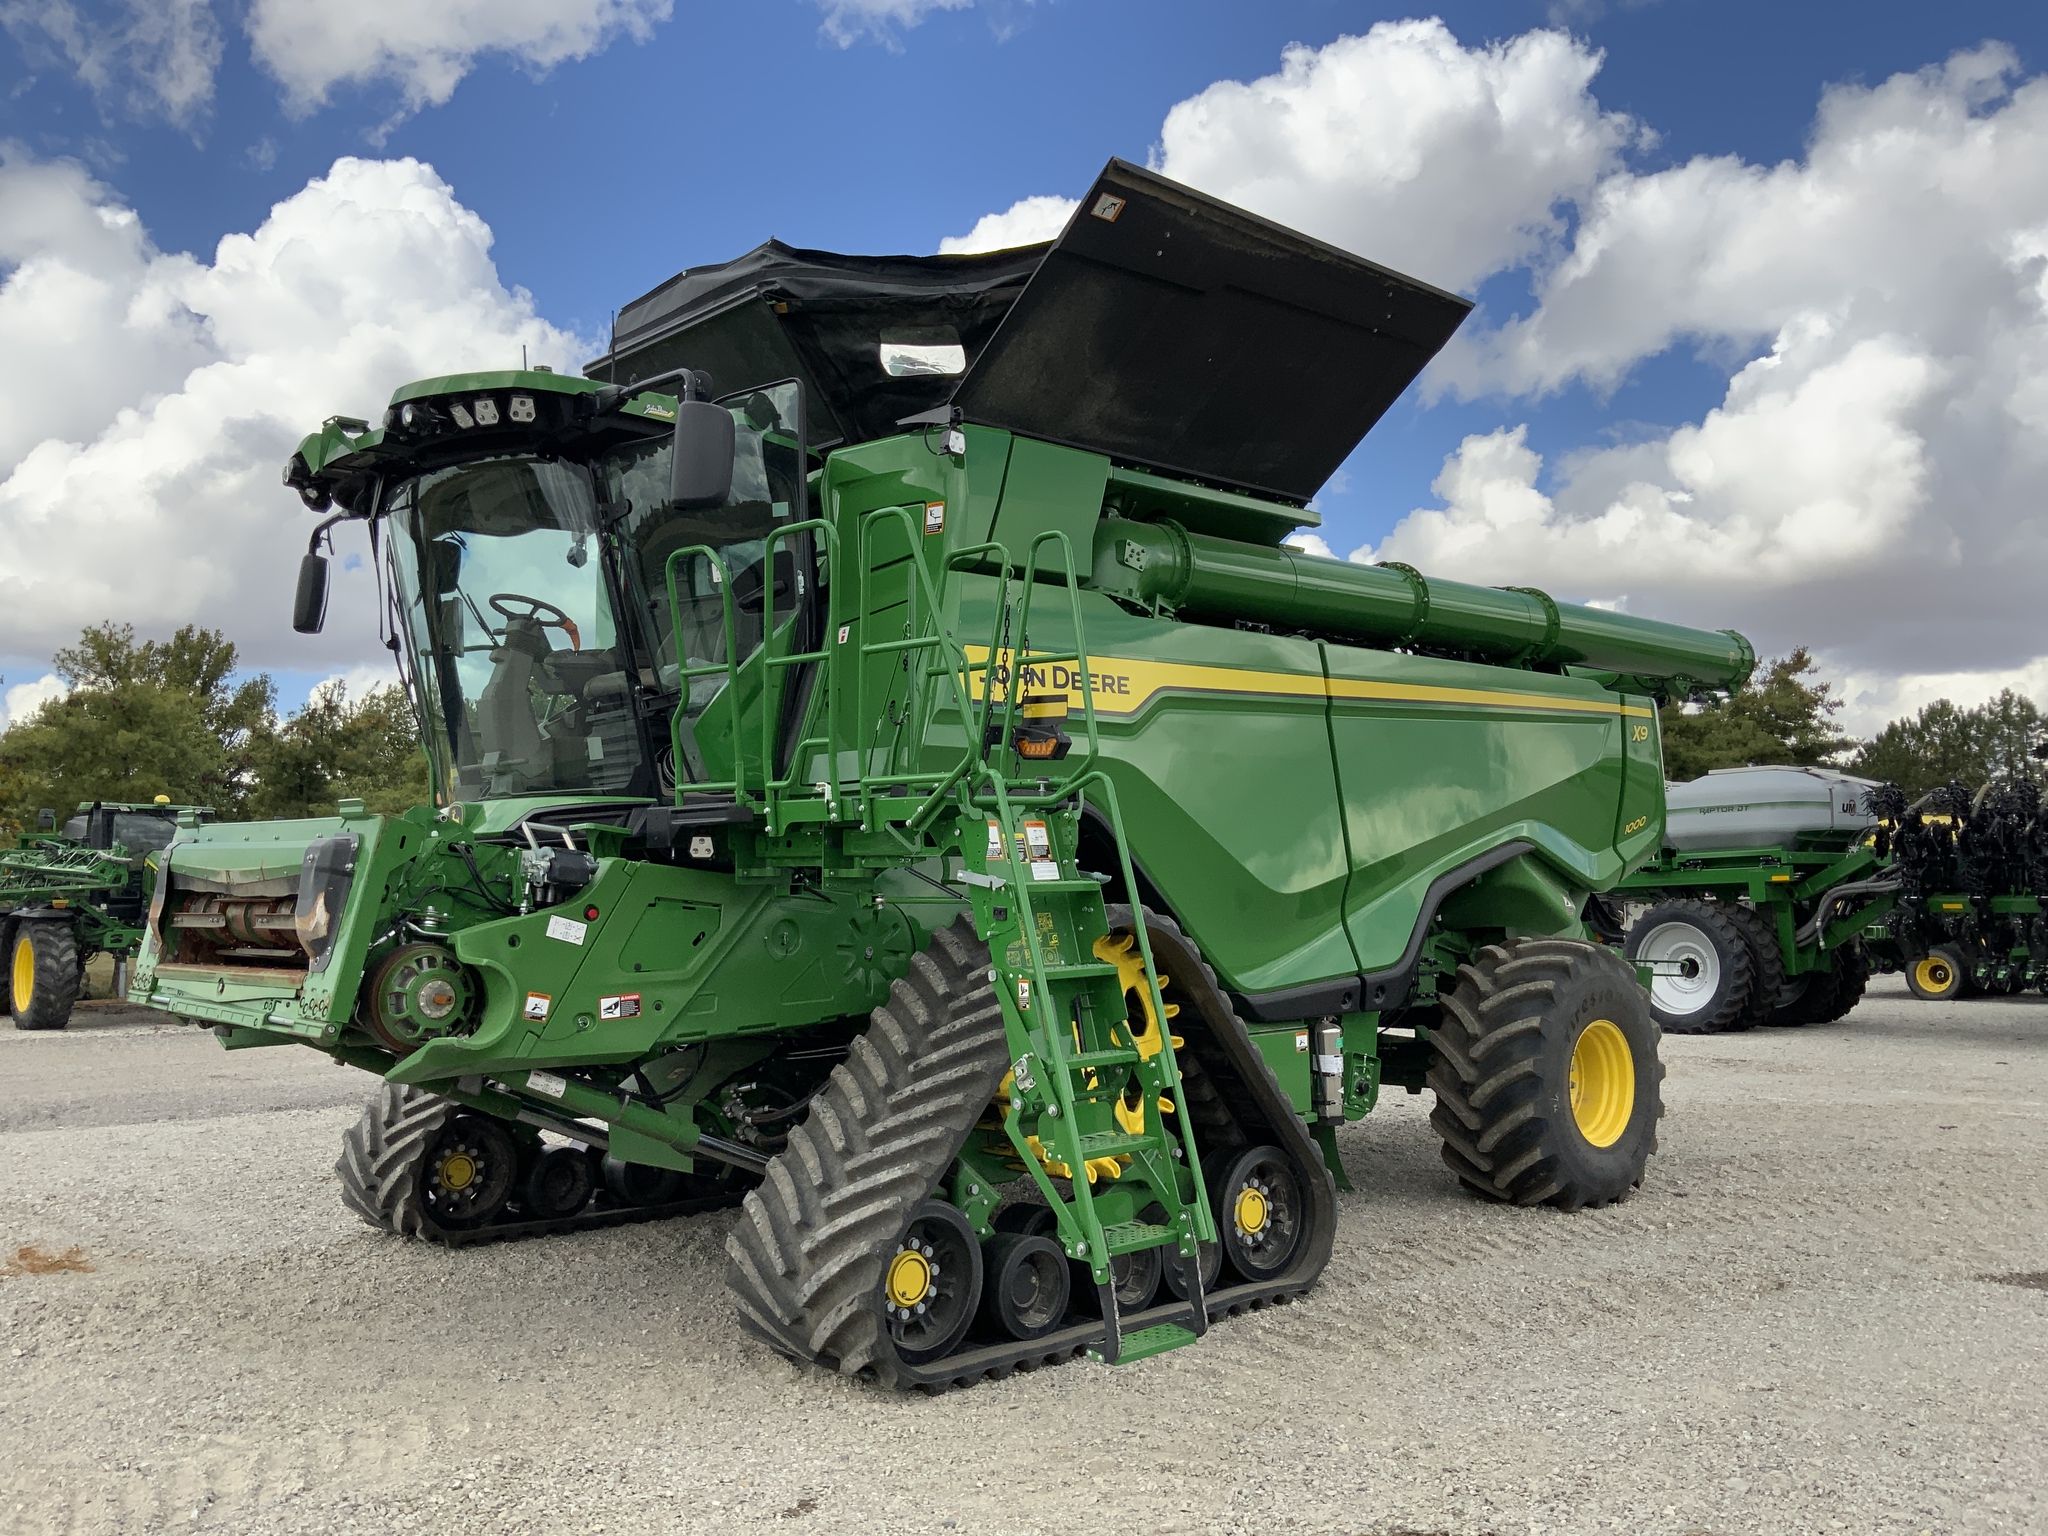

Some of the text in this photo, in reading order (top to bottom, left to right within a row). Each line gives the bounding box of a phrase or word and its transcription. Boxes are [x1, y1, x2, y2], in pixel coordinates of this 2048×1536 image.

[1052, 665, 1130, 695] DEERE
[1632, 724, 1649, 742] X9
[1699, 804, 1750, 816] RAPTOR DT
[1624, 815, 1647, 835] 1000
